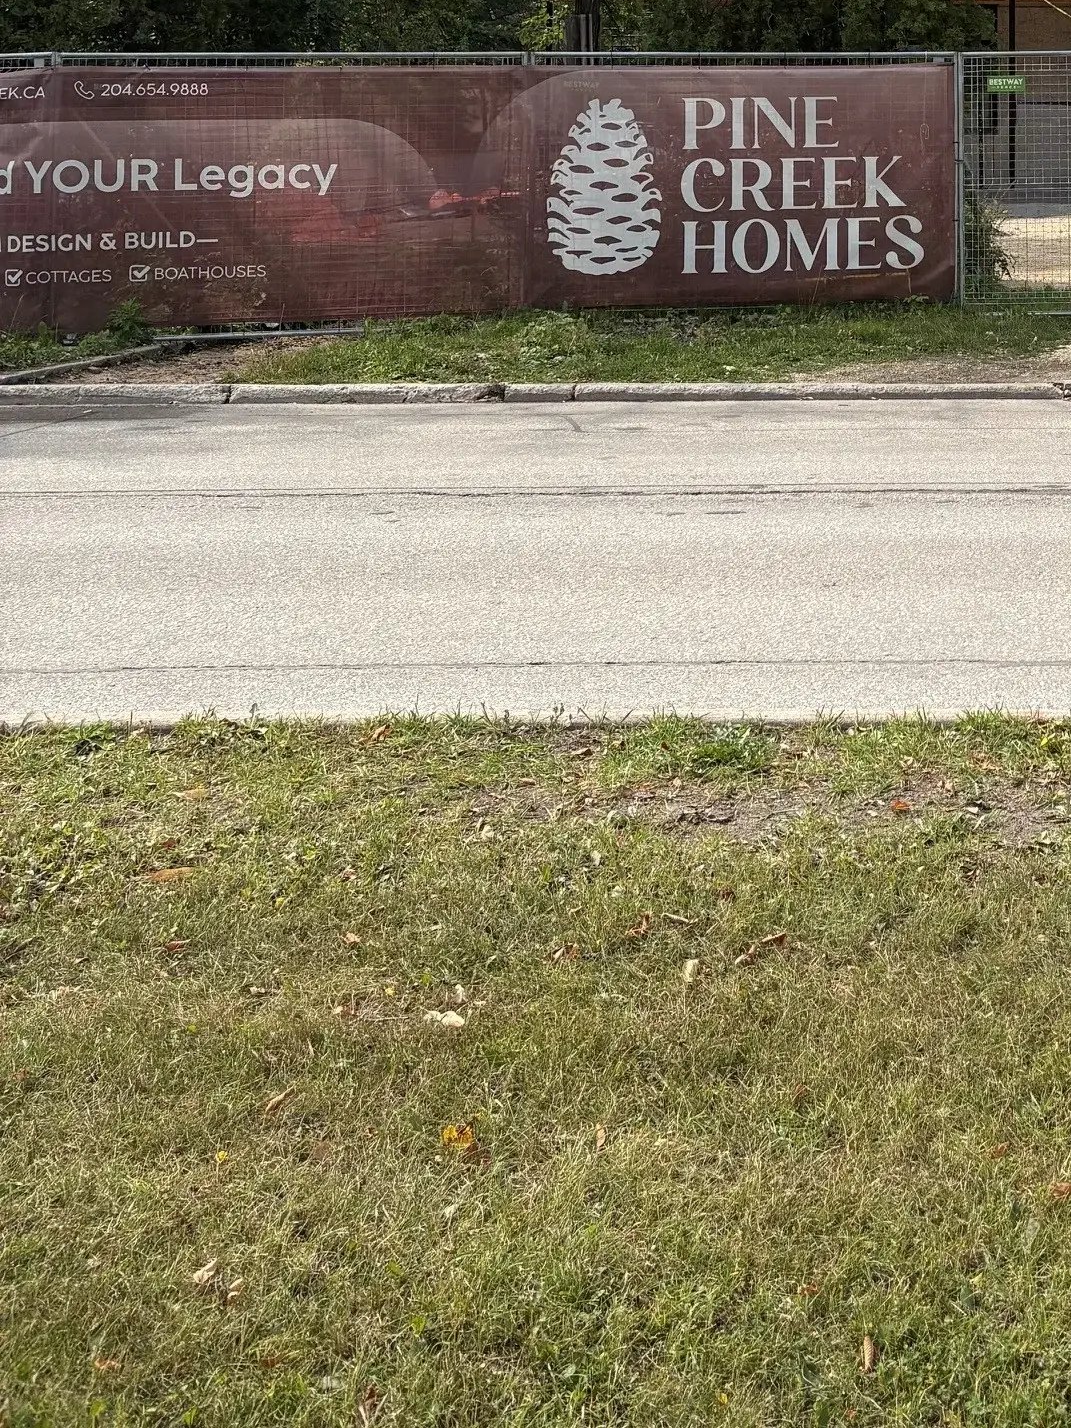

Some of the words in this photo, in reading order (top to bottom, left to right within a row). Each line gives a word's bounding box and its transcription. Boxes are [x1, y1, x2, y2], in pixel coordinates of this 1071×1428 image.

[100, 82, 209, 97] 204.654.9888
[988, 78, 1024, 86] BESTWAY
[0, 86, 46, 100] EK.CA
[682, 97, 840, 150] PINE
[23, 158, 159, 194] YOUR
[175, 159, 338, 198] Legacy
[680, 155, 908, 213] CREEK
[7, 233, 92, 253] DESIGN
[99, 233, 117, 251] &
[681, 216, 926, 275] HOMES
[25, 269, 112, 285] COTTAGES
[154, 264, 267, 281] BOATHOUSES
